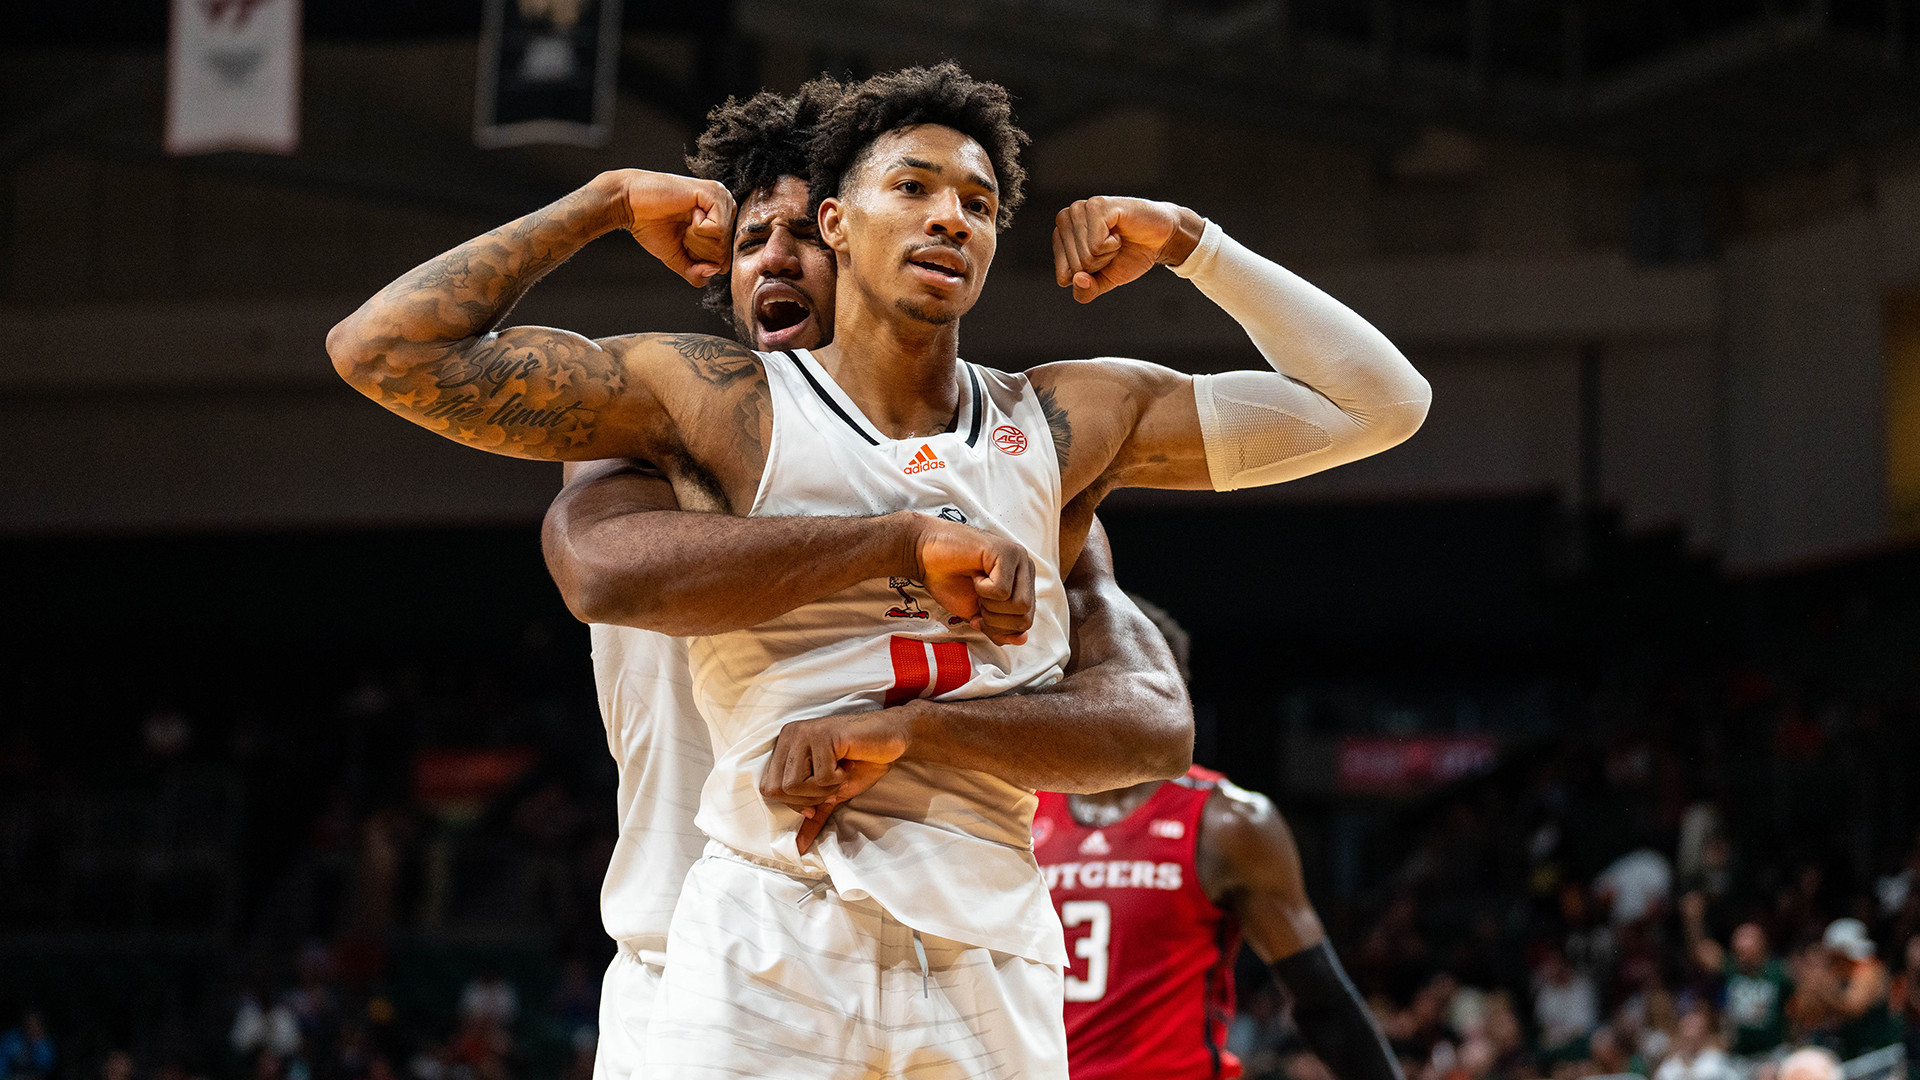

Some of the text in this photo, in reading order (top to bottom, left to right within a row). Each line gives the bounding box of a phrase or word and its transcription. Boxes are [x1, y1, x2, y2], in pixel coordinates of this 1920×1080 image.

[436, 348, 542, 397] Sky's
[424, 394, 600, 428] the limit
[996, 434, 1025, 444] ACC
[903, 460, 946, 475] adidas
[1040, 861, 1182, 889] UTGERS
[1062, 901, 1111, 1003] 3
